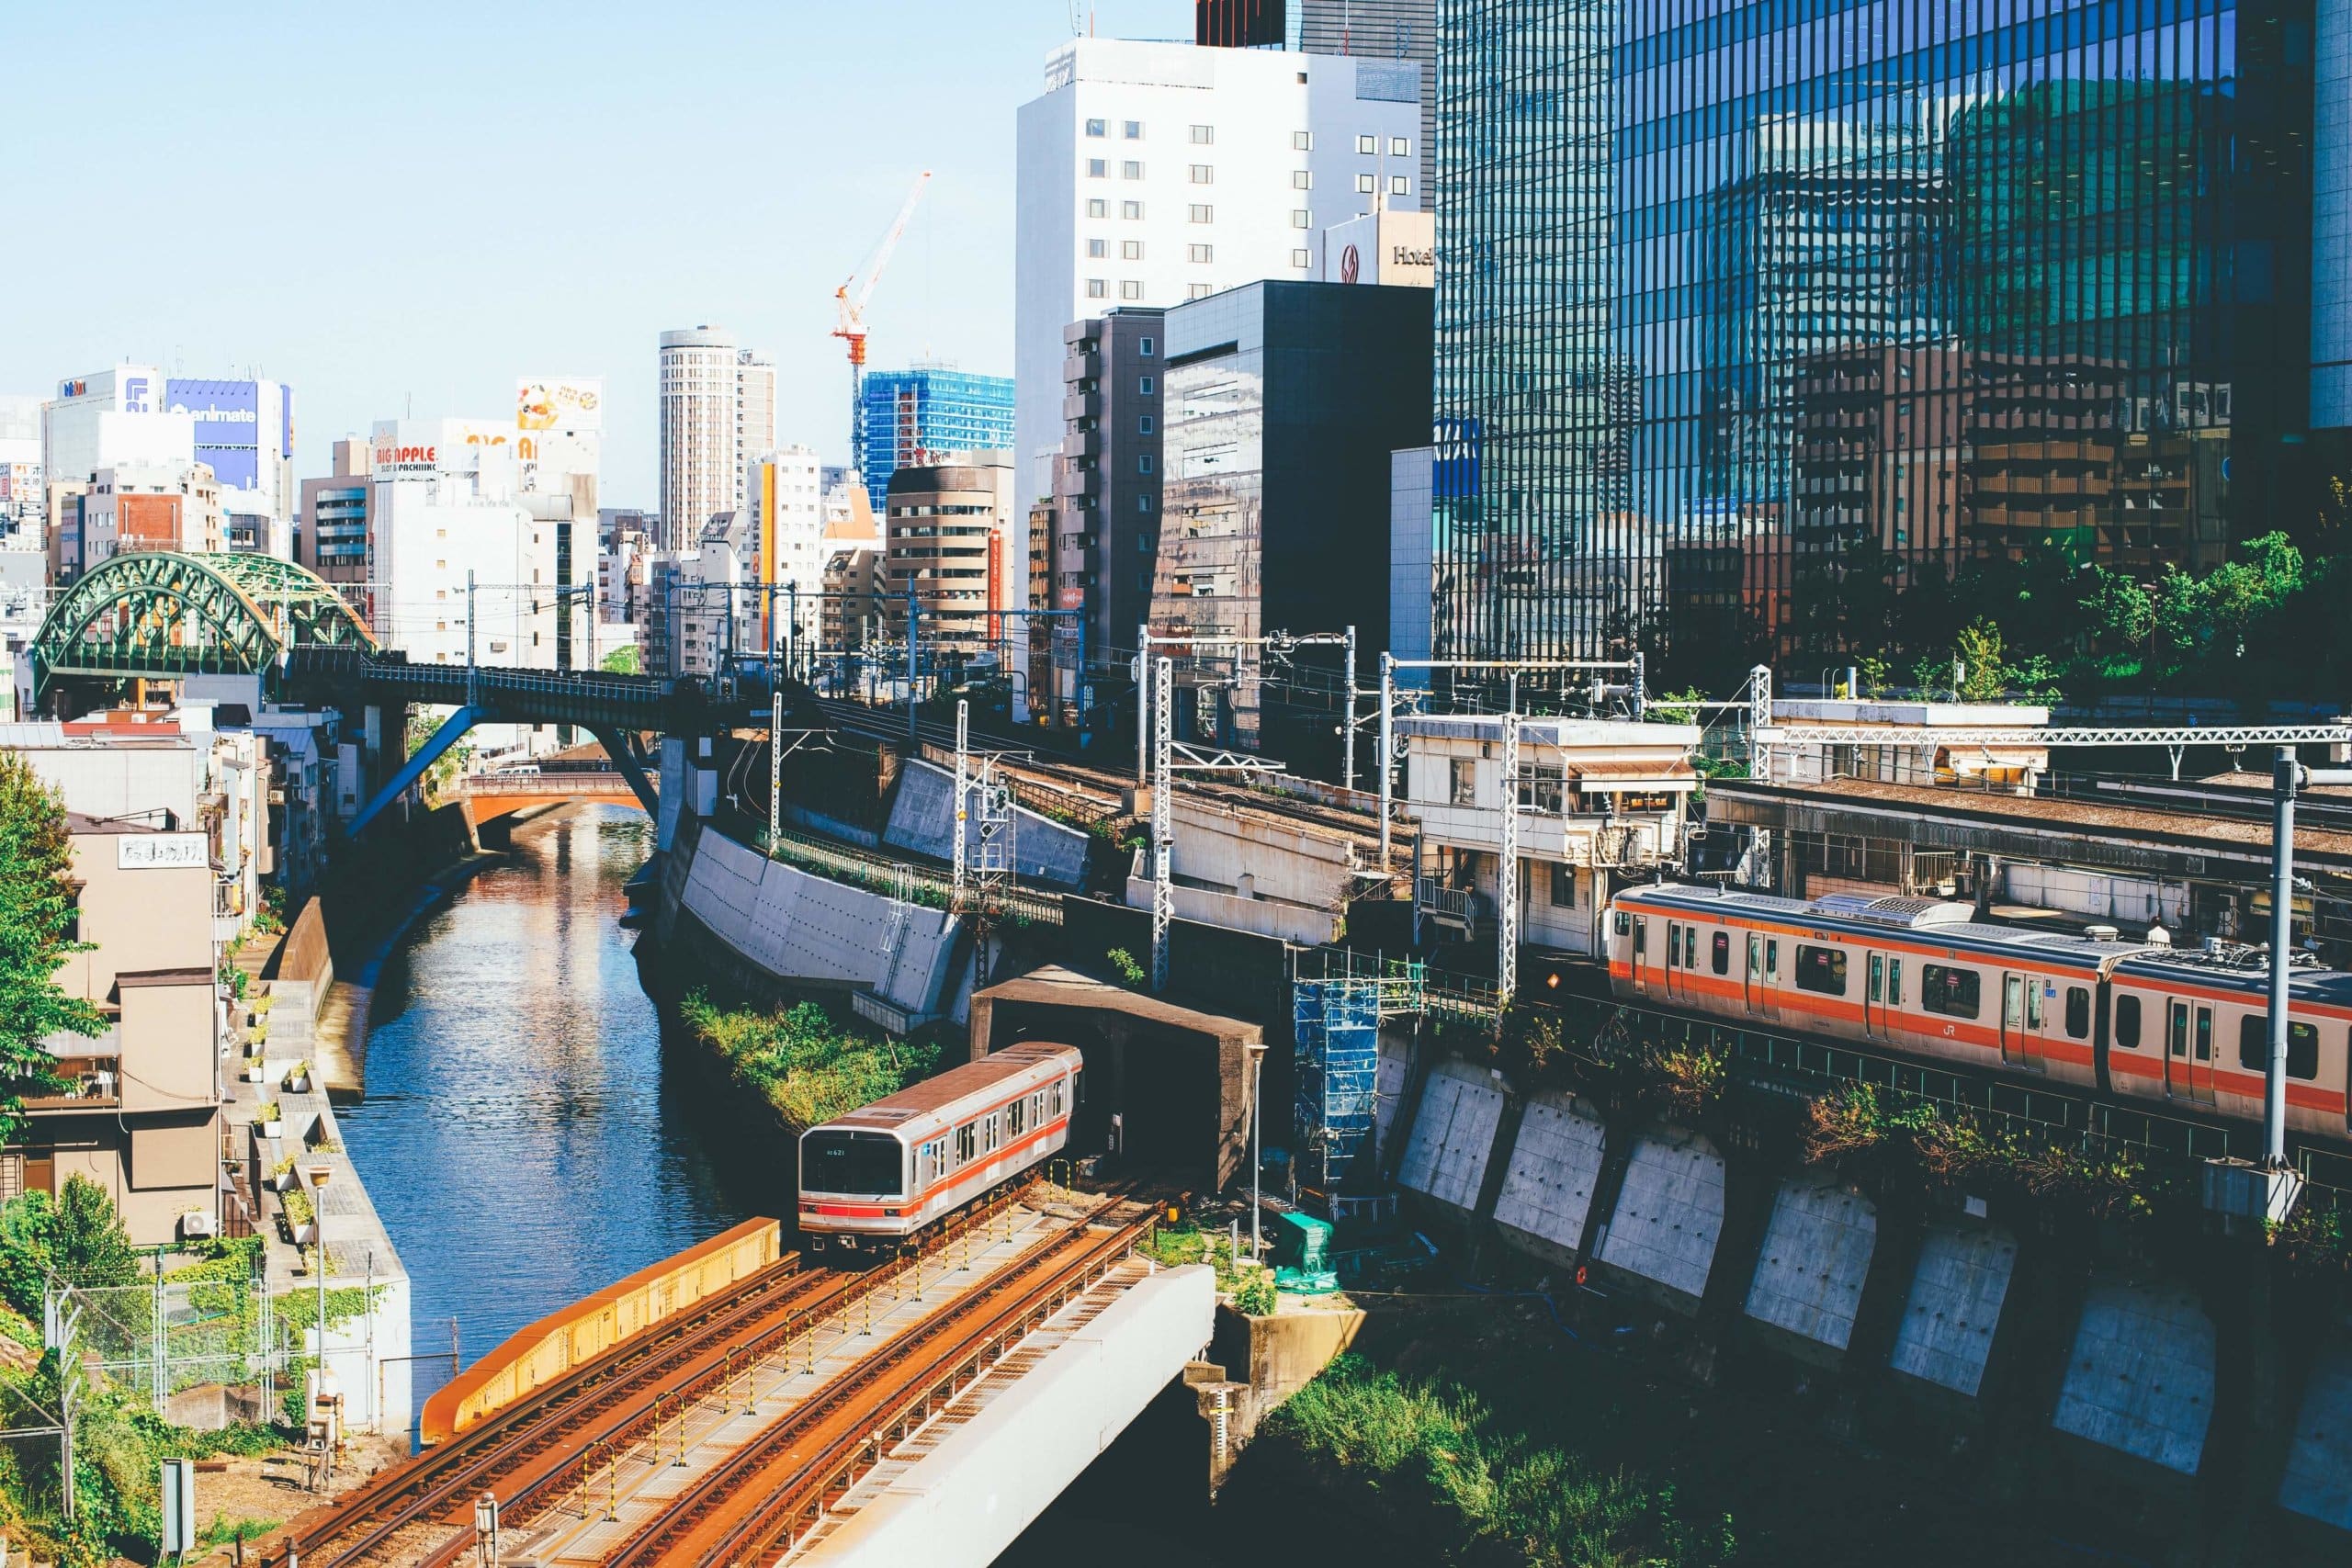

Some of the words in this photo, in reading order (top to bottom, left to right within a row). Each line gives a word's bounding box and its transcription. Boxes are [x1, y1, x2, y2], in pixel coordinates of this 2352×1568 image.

[1393, 245, 1435, 265] Hotel
[395, 446, 435, 463] APPLE
[1943, 1025, 1955, 1036] JR
